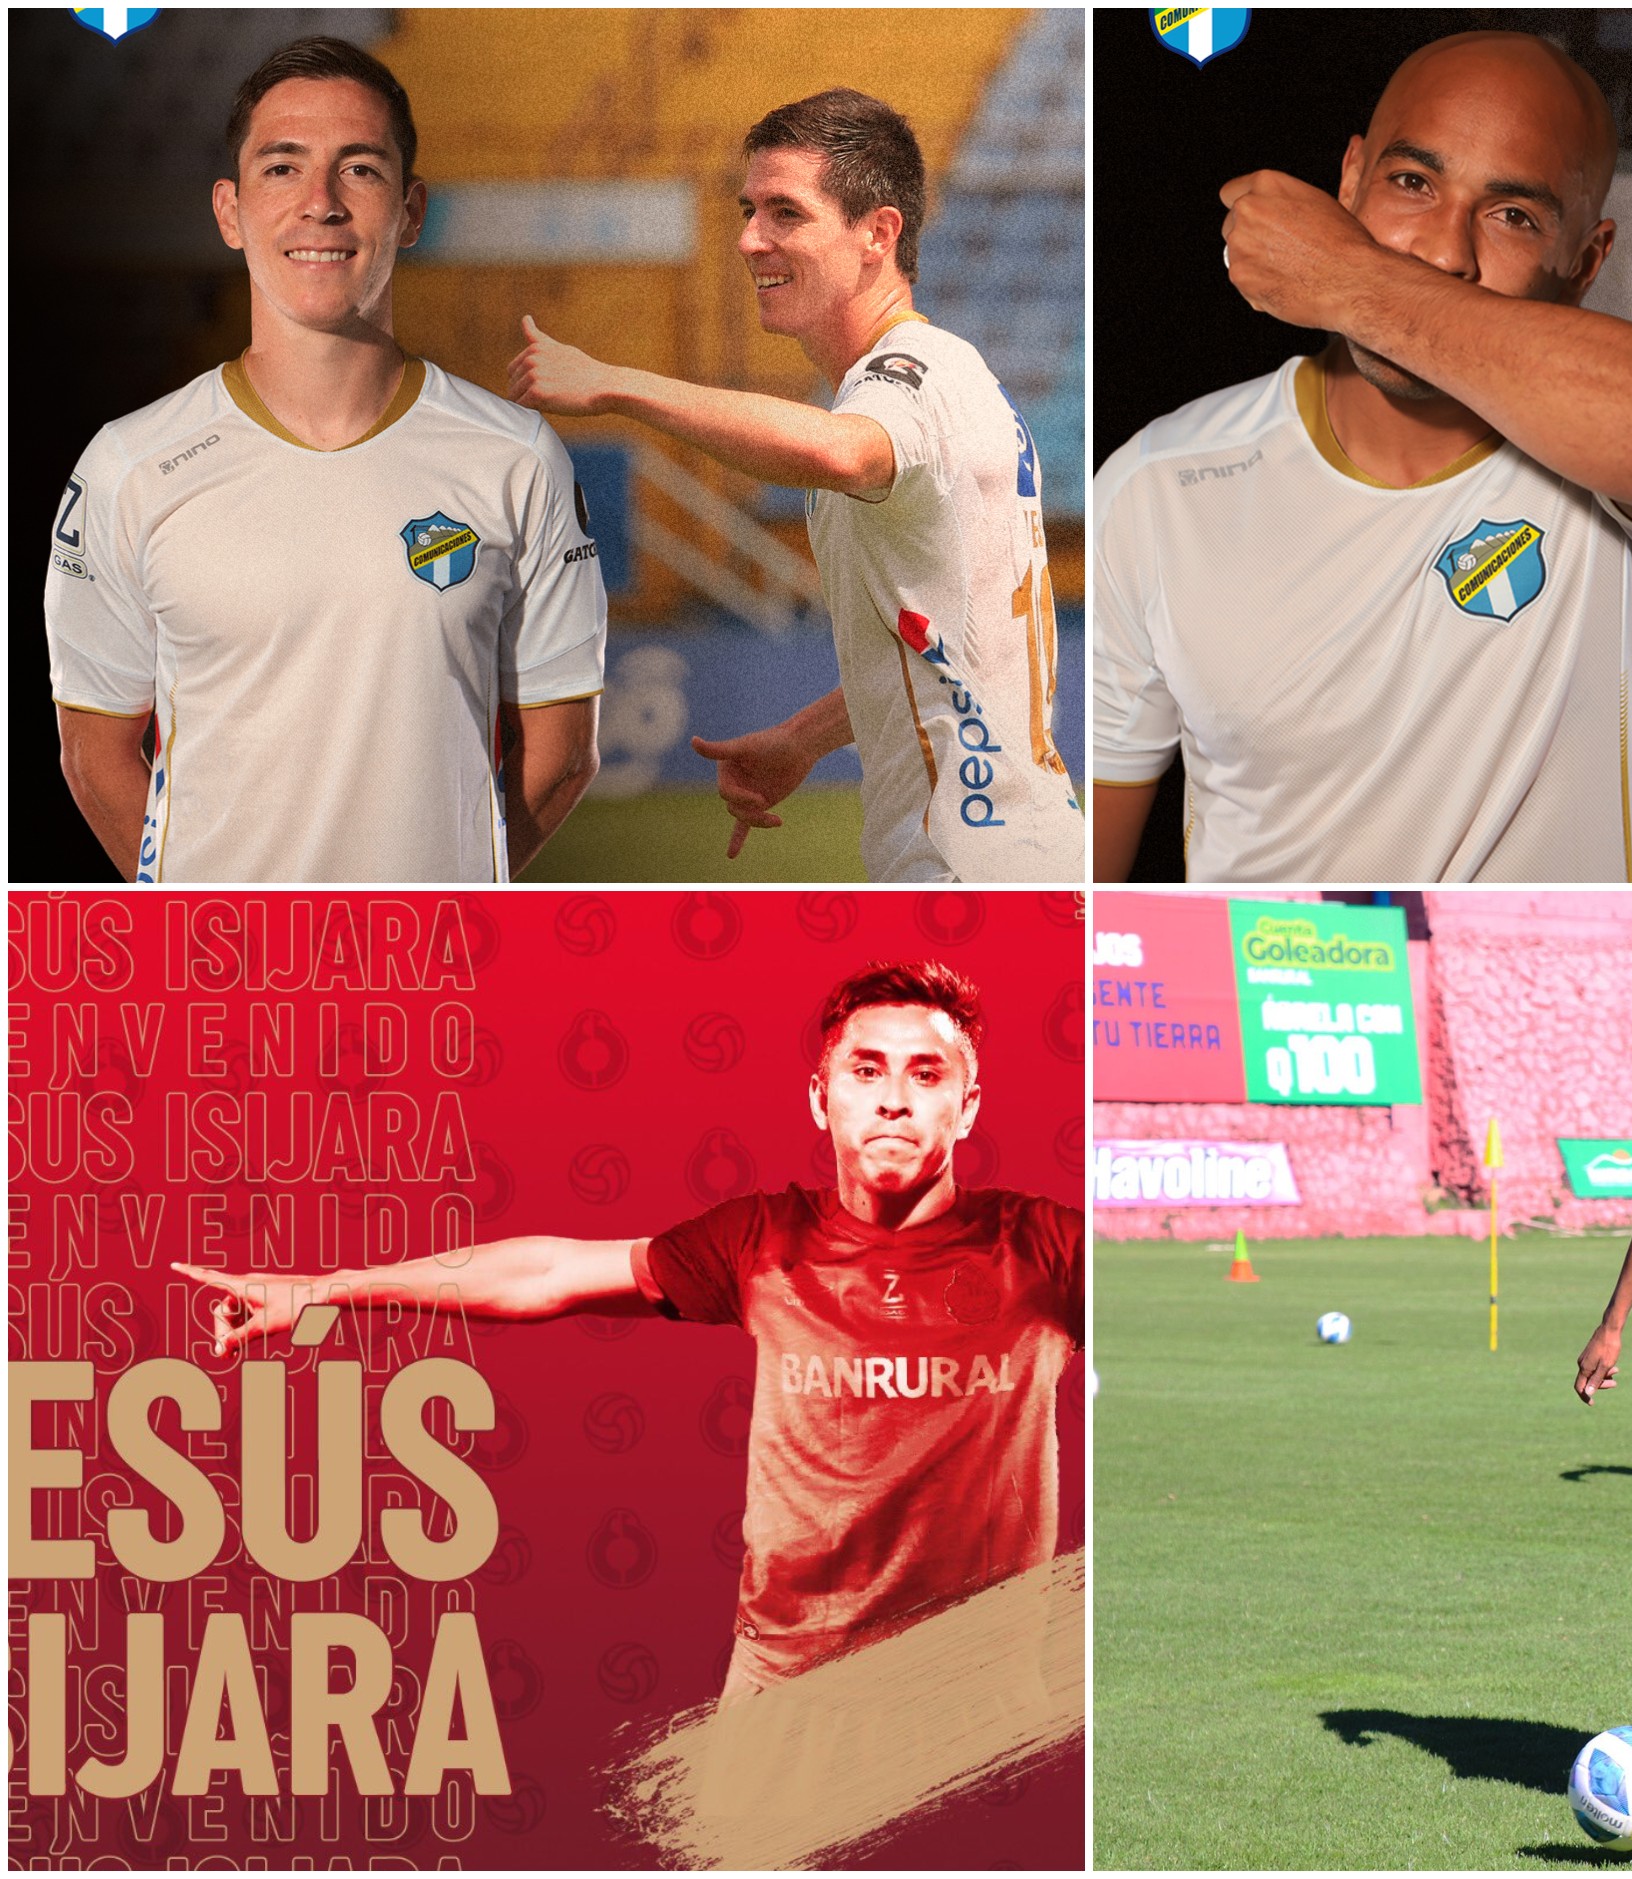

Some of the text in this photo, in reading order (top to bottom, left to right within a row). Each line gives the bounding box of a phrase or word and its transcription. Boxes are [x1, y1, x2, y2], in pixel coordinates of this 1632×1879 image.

[54, 554, 82, 574] GAS
[413, 530, 472, 567] COMUNICACIONES
[1458, 527, 1532, 602] COMUNICACIONES
[938, 675, 1006, 829] pepsi
[1247, 937, 1390, 966] Goleadora
[1093, 979, 1167, 1009] ENTE
[1130, 1021, 1221, 1050] TIERRA
[1093, 1147, 1273, 1201] Havoline
[781, 1353, 1015, 1399] BANRURAL
[1580, 1796, 1624, 1829] molten
